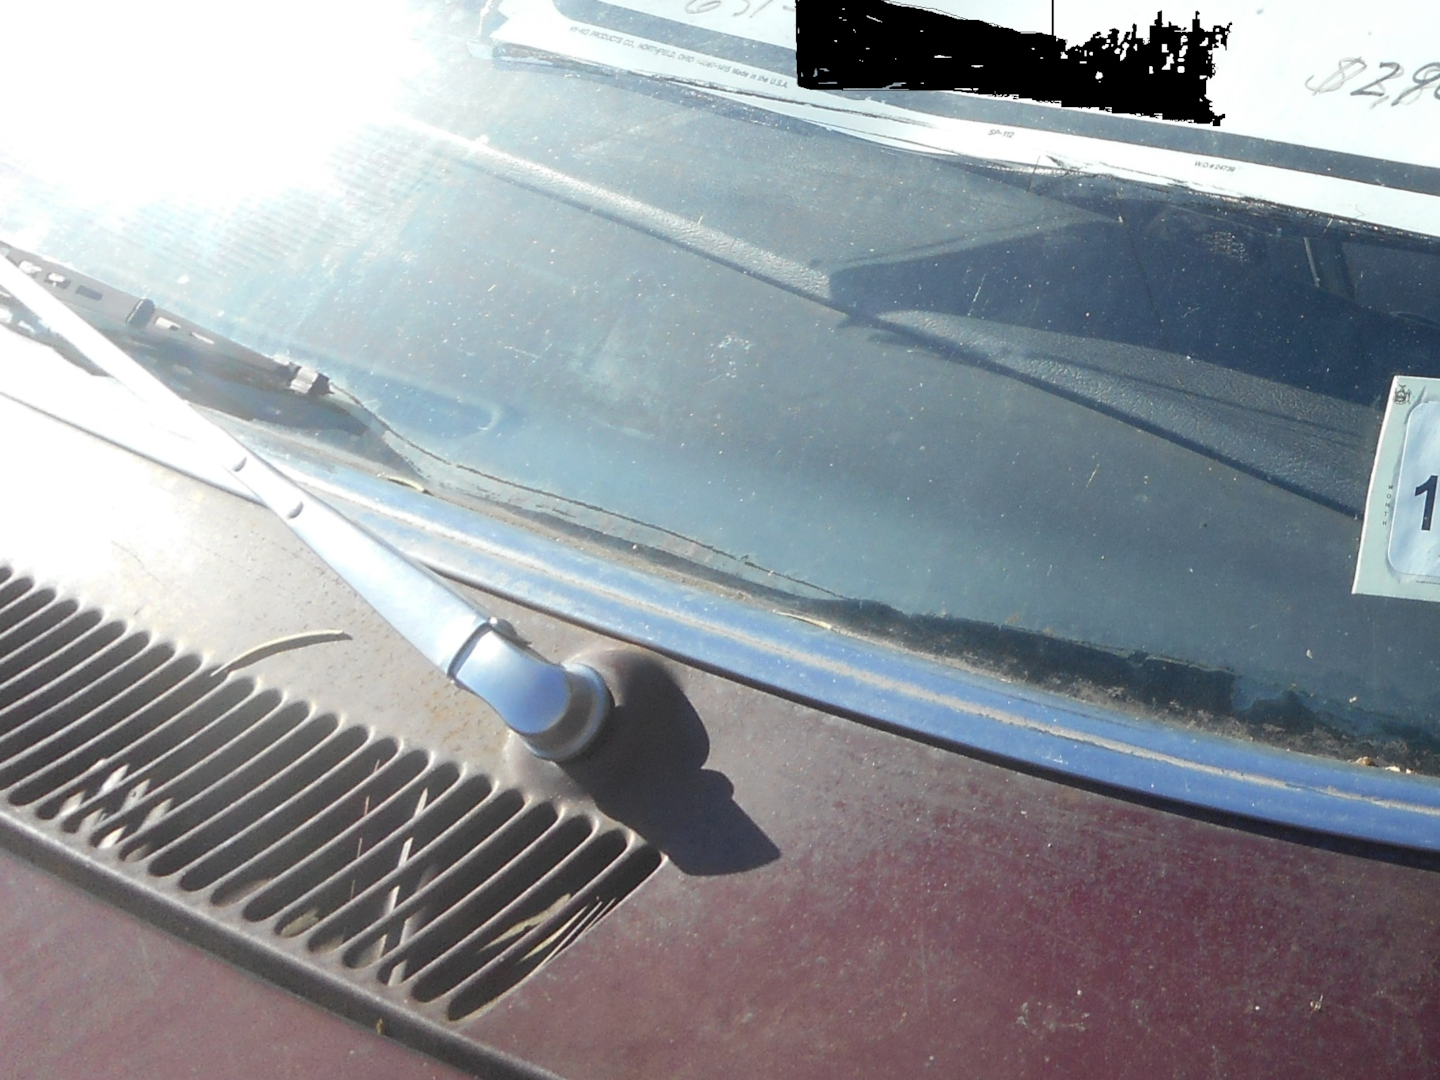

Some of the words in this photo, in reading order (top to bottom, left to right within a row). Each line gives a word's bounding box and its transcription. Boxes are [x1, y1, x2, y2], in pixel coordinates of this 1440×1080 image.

[589, 30, 624, 44] PRODUCTS
[731, 66, 750, 79] Made
[757, 74, 769, 83] the
